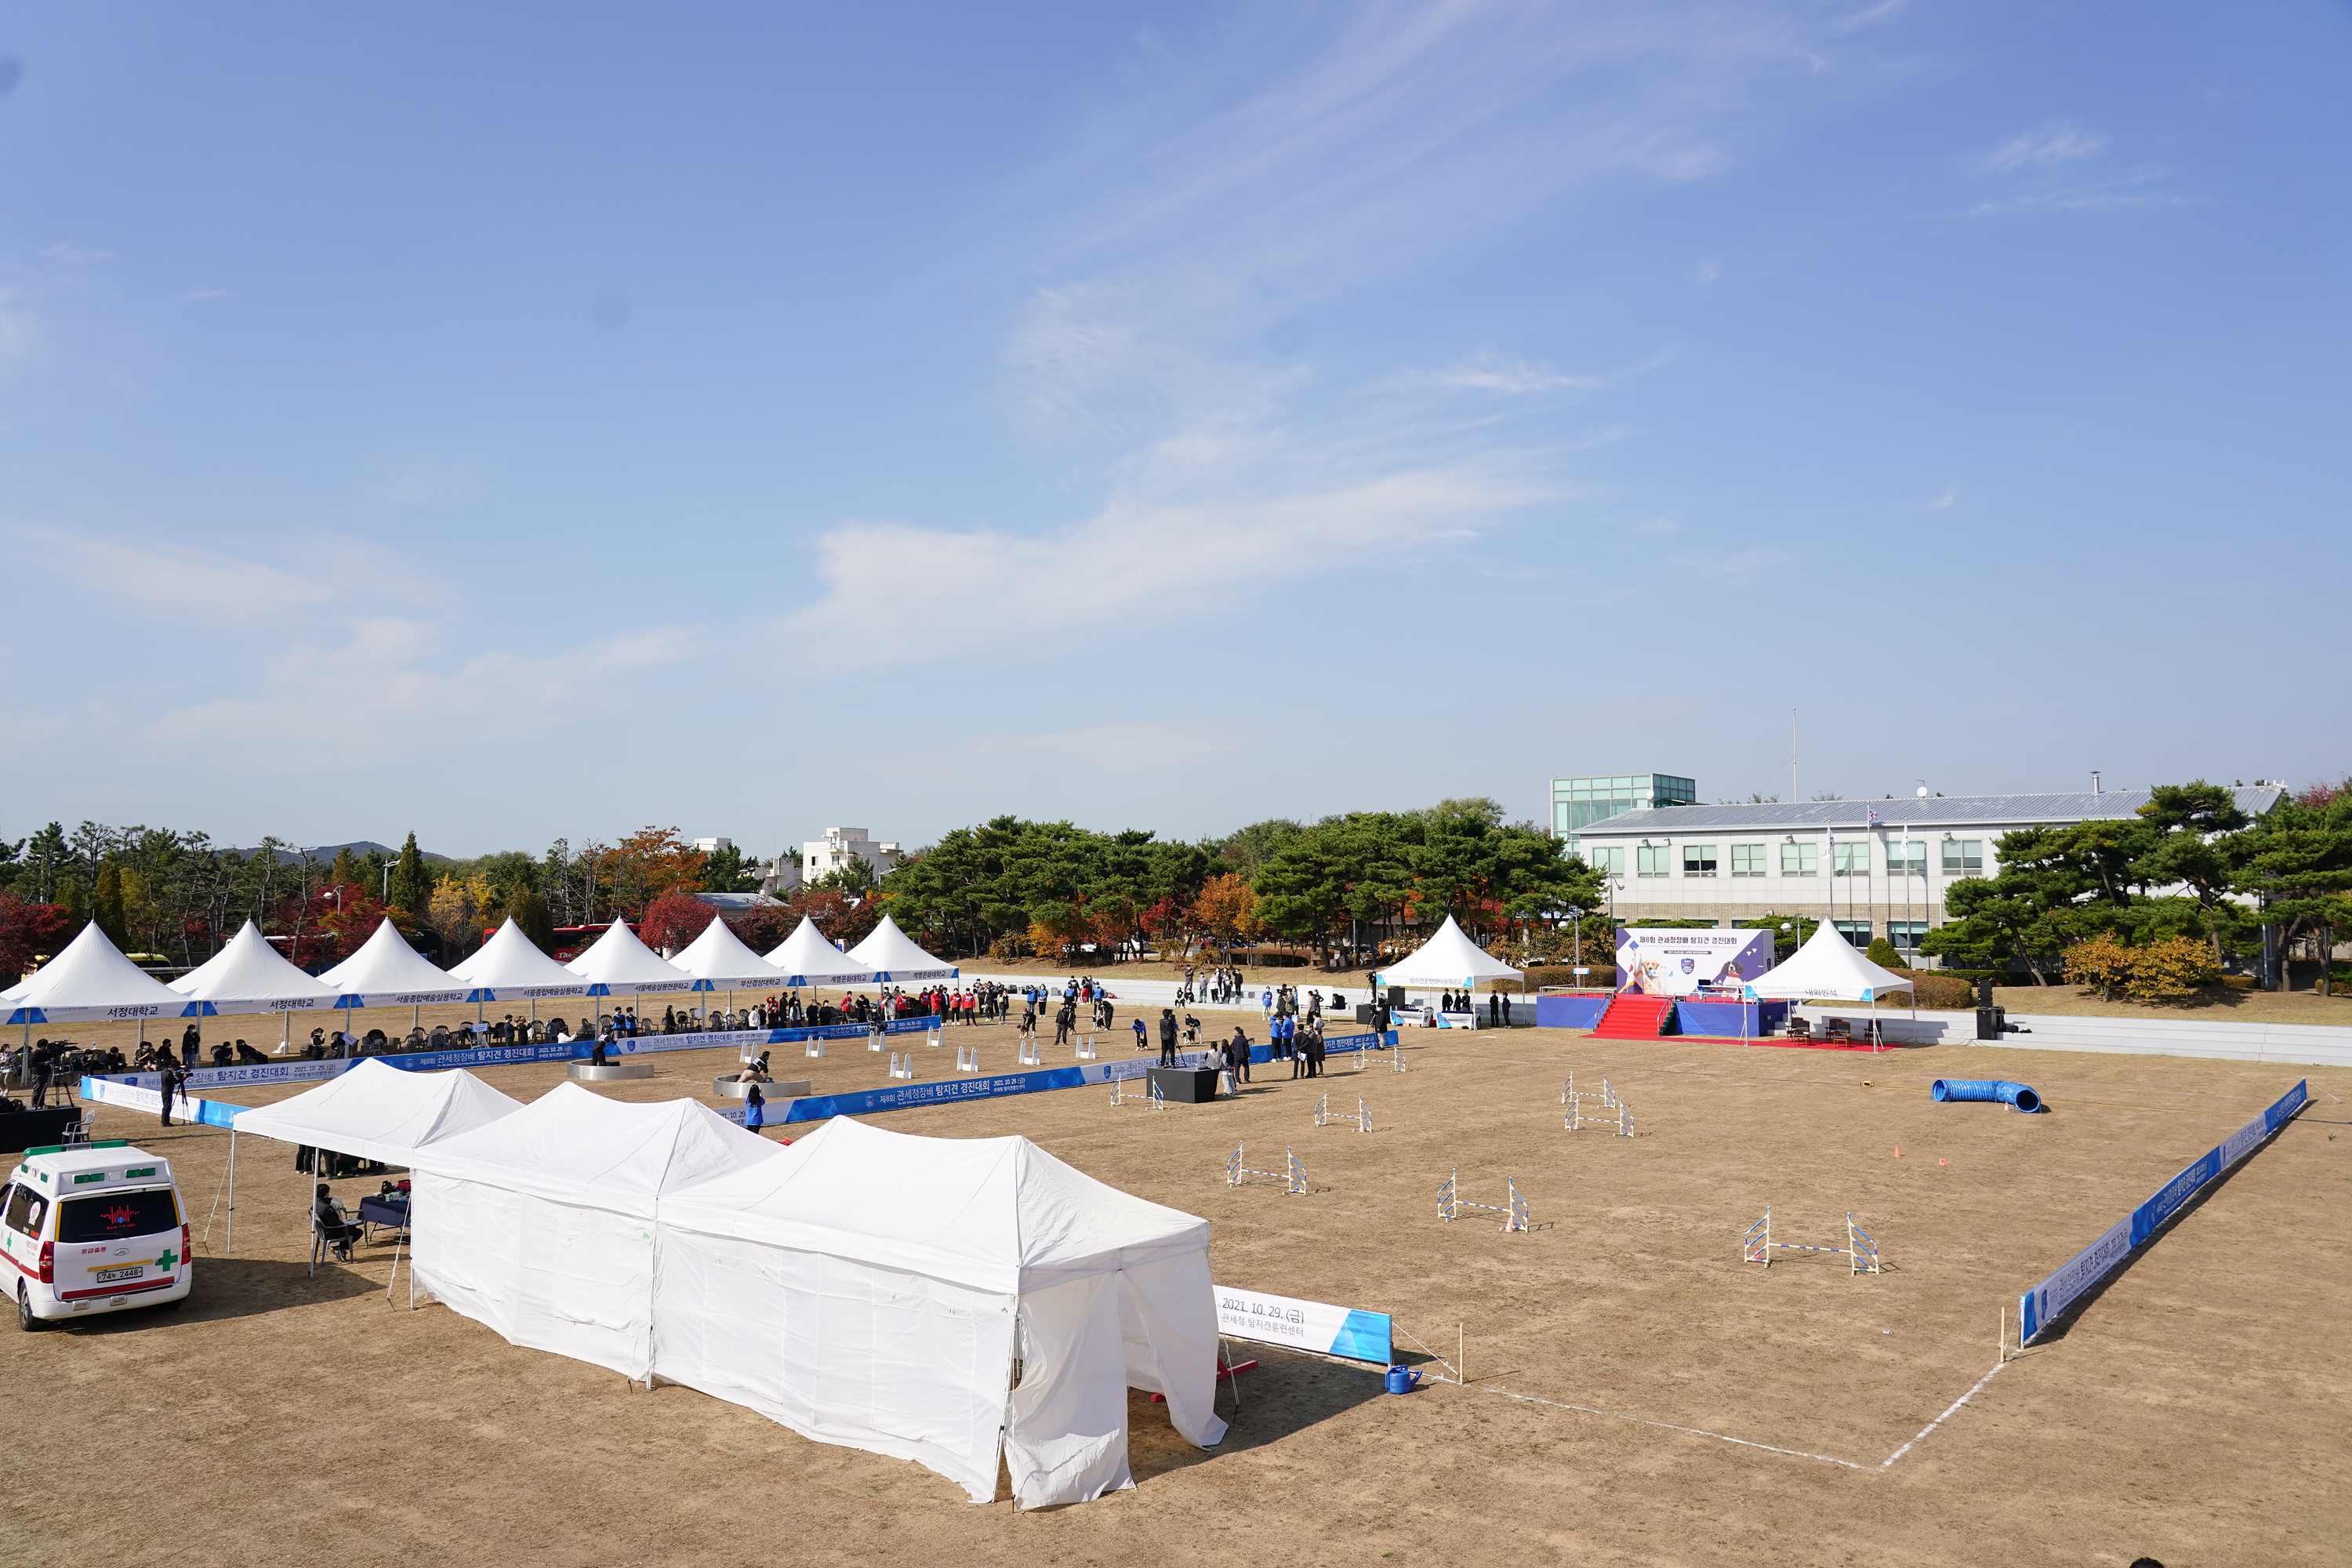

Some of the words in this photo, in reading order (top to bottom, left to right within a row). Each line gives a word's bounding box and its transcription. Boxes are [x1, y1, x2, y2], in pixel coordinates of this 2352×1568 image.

[1639, 935, 1656, 944] 제8회
[1657, 936, 1689, 945] 관세청장배
[1711, 937, 1737, 946] 경진대회
[830, 975, 866, 984] 계명문화대학교
[523, 986, 583, 997] 서울종합예술실용학교
[270, 998, 314, 1009] 서정대학교
[395, 993, 463, 1004] 서울종합예술실용학교
[107, 1006, 158, 1018] 서정대학교
[686, 1034, 705, 1043] 탐지견
[707, 1033, 733, 1043] 경진대회
[437, 1053, 475, 1064] 관세청장배
[477, 1050, 501, 1060] 탐지견
[503, 1047, 535, 1058] 경진대회
[217, 1069, 247, 1081] 탐지견
[250, 1066, 289, 1078] 경진대회
[880, 1094, 895, 1103] 제8회
[897, 1087, 934, 1101] 관세청장배
[935, 1083, 958, 1097] 탐지견
[960, 1080, 990, 1094] 경진대회
[119, 1269, 139, 1278] 2448
[1222, 1298, 1248, 1312] 2021.
[1251, 1303, 1265, 1316] 10.
[1269, 1305, 1283, 1319] 29.
[1286, 1308, 1304, 1324] (금)
[1222, 1312, 1245, 1326] 관세청
[1248, 1317, 1304, 1338] 탐지견훈련센터
